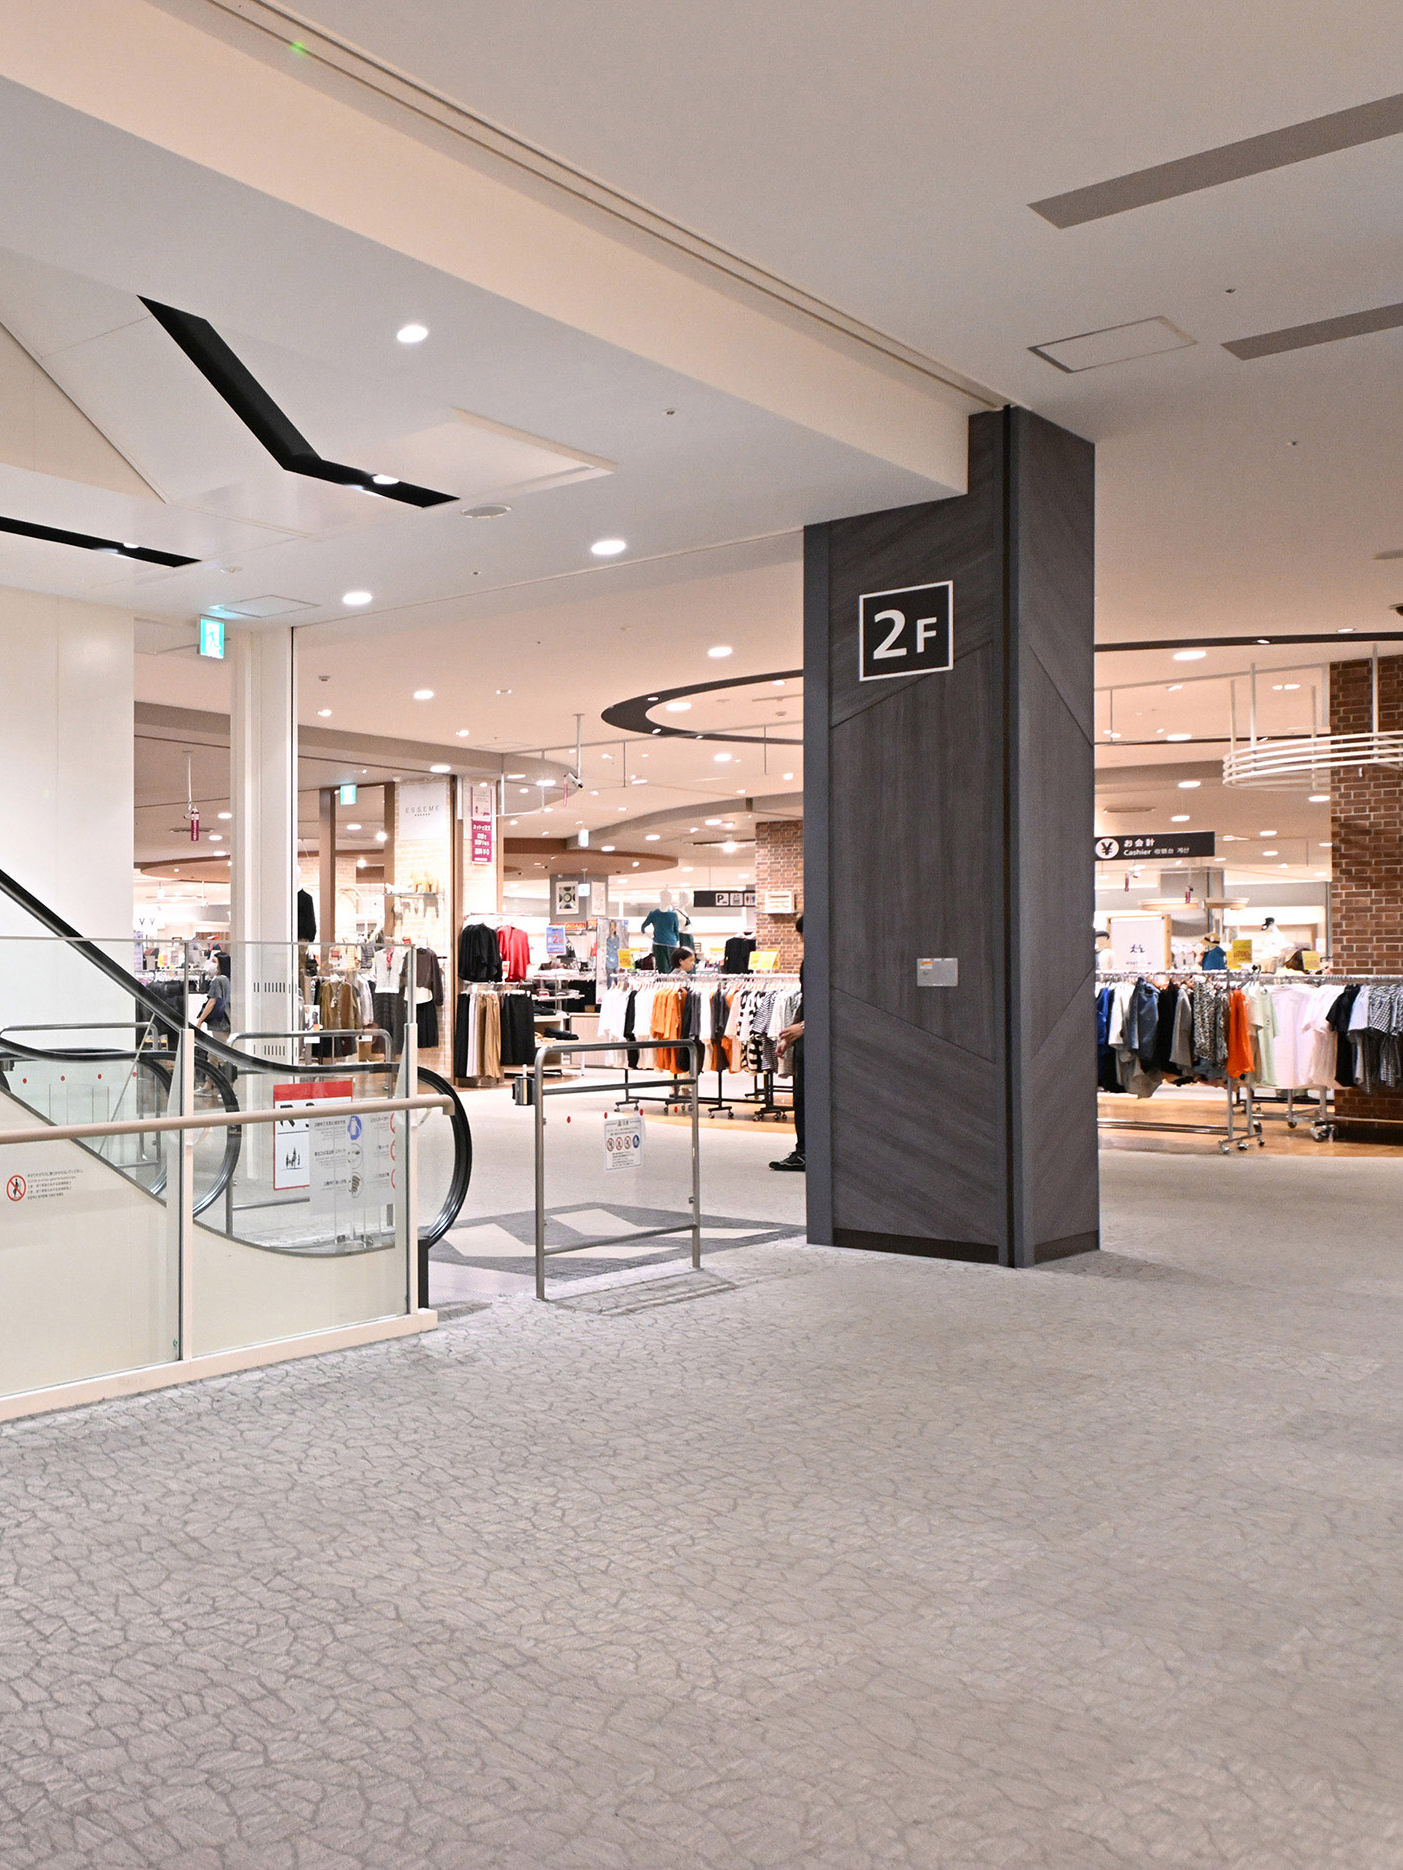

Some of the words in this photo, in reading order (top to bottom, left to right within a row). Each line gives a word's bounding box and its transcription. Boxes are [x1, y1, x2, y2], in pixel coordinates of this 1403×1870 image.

[872, 608, 938, 660] 2F
[405, 805, 440, 814] ESSEME
[1123, 837, 1155, 848] お会計
[1123, 848, 1152, 856] Cashier
